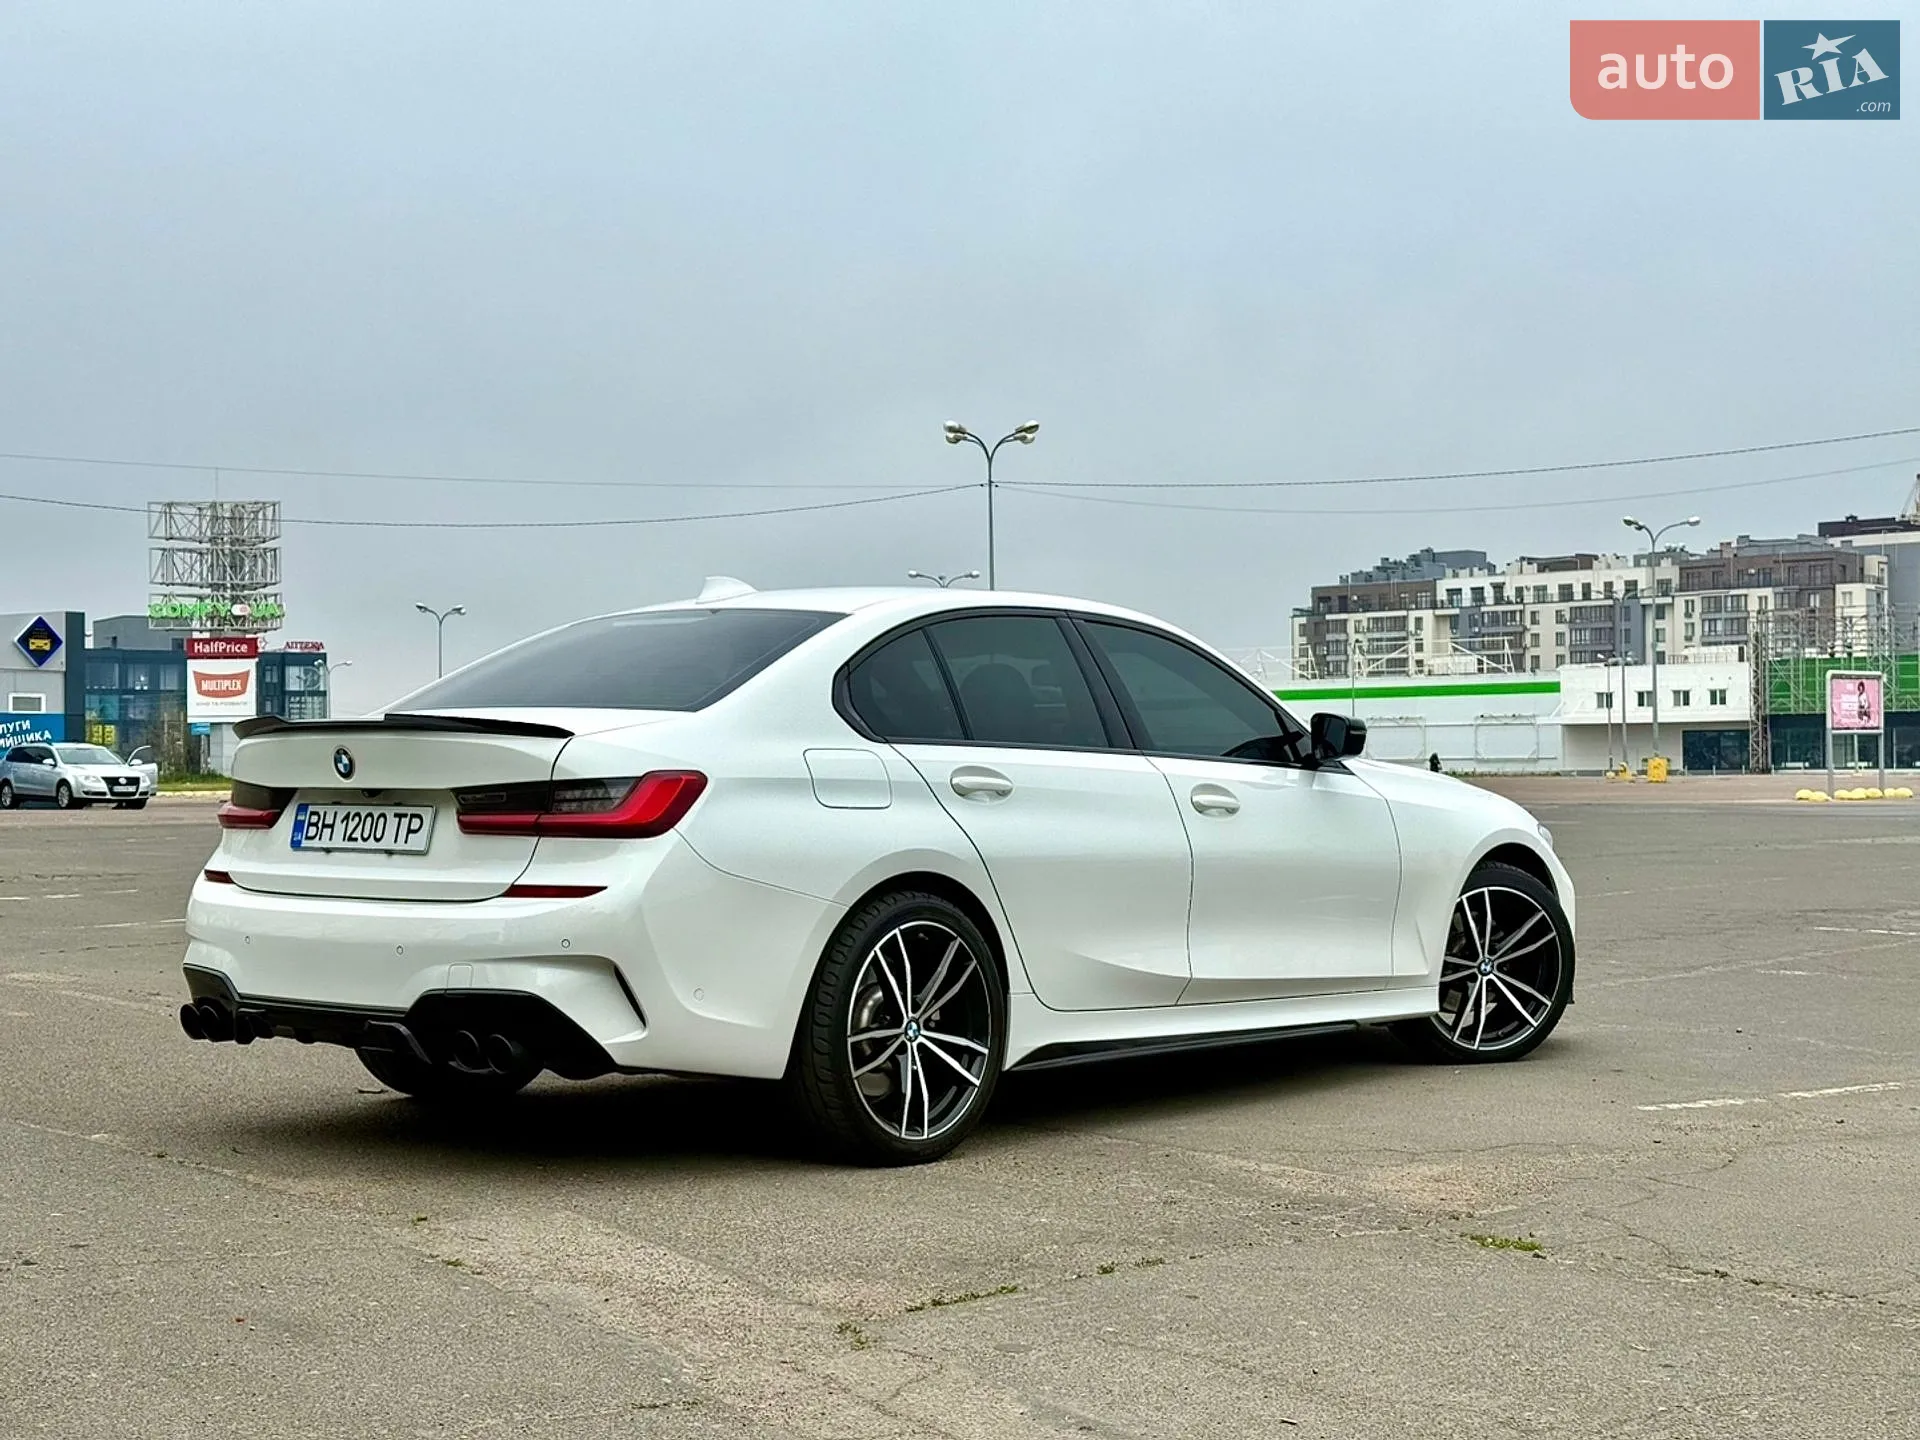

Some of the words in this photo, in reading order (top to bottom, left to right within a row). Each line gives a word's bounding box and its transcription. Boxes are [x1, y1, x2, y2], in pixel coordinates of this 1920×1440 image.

[148, 602, 232, 618] COMFY
[194, 641, 248, 654] HalfPrice
[201, 679, 242, 692] MULTIPLEX
[305, 810, 338, 841] BH
[341, 811, 388, 843] 1200
[393, 812, 424, 844] TP
